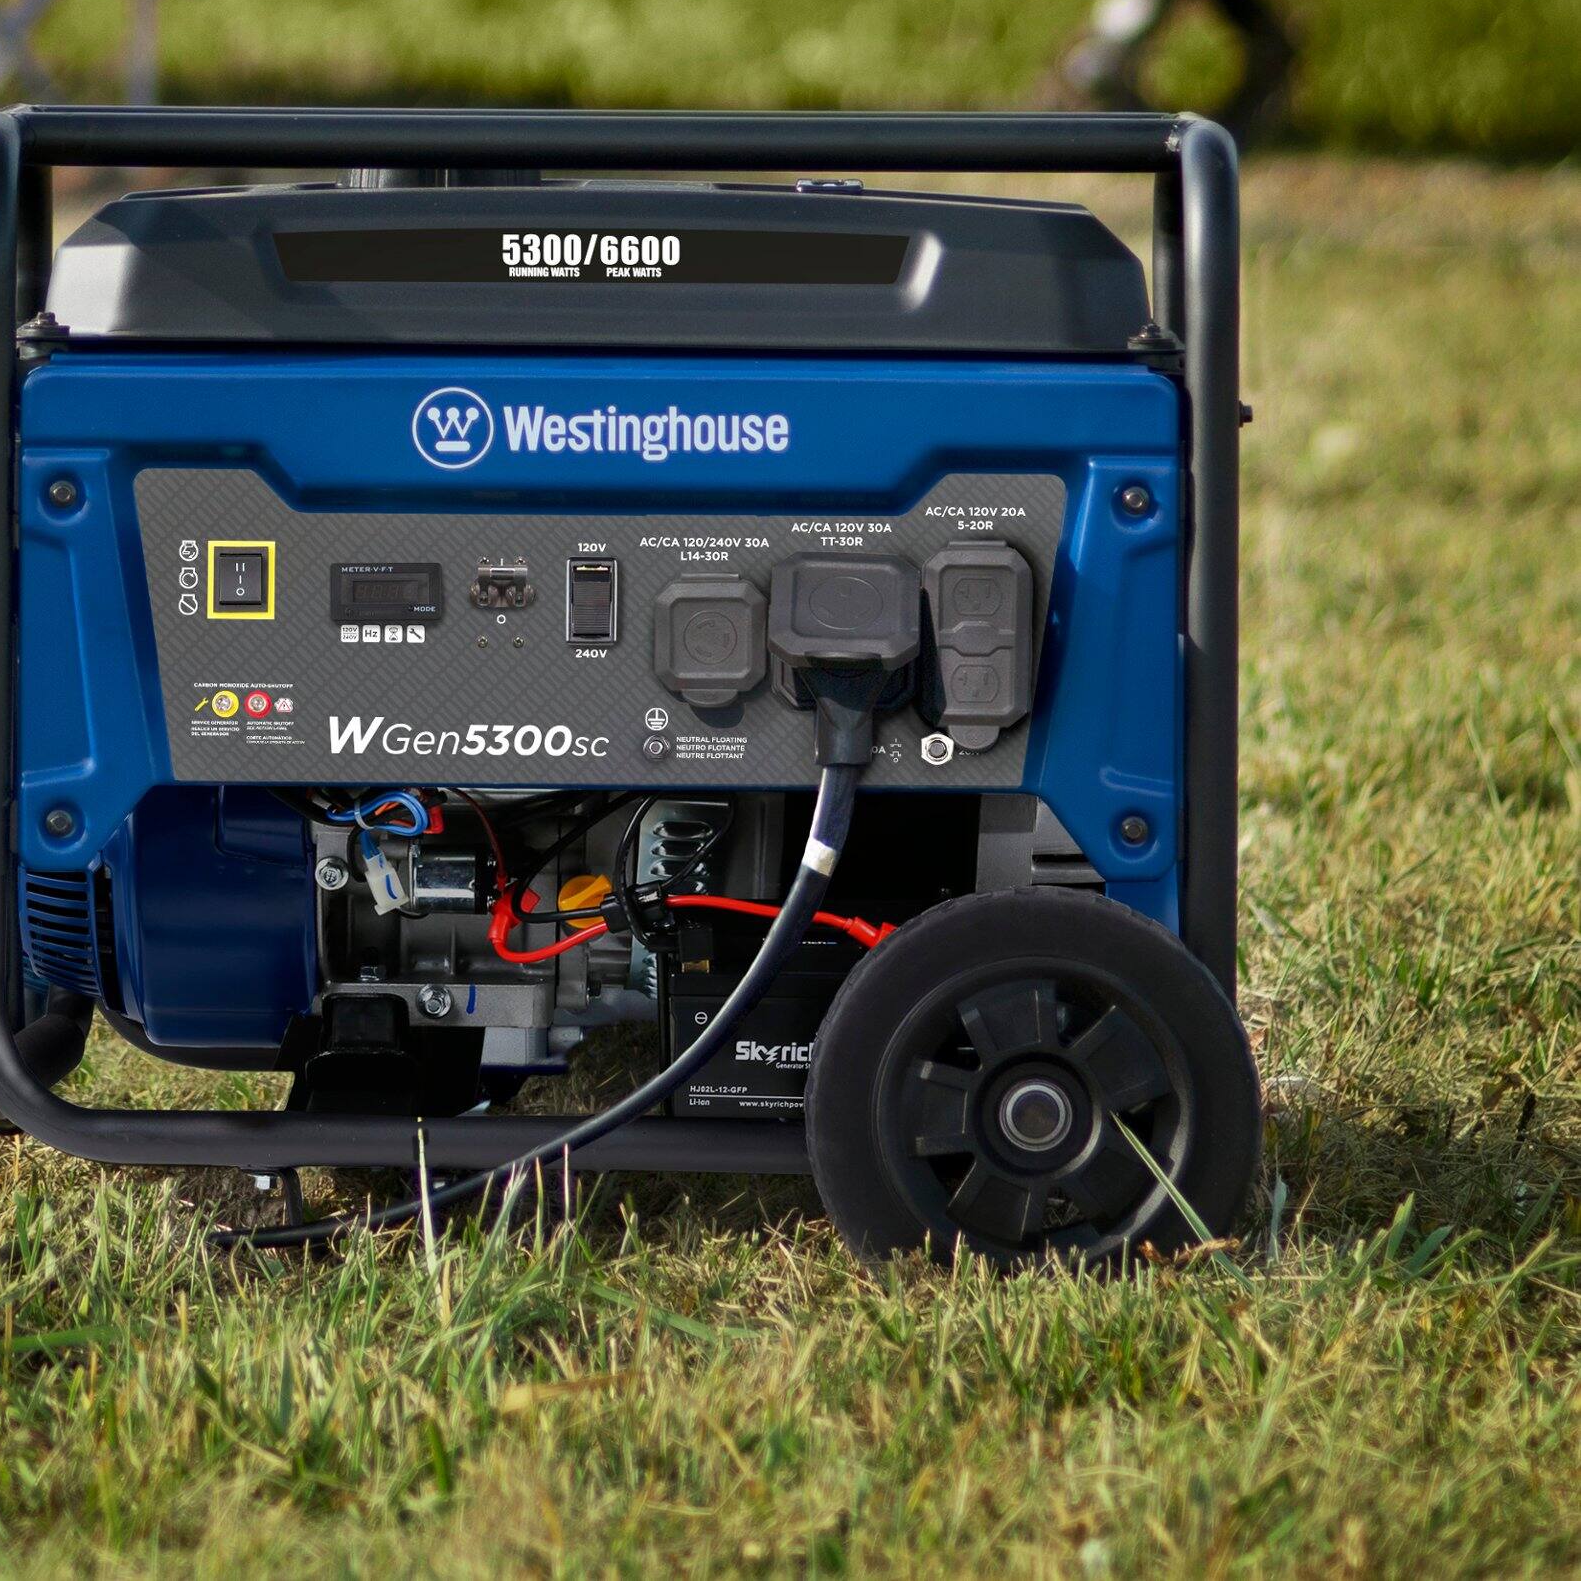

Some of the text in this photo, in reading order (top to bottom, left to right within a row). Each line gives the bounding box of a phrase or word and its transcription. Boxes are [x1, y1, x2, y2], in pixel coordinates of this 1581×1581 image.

[502, 233, 681, 266] 5300/6600
[509, 267, 581, 278] RUNNING WATTS
[606, 267, 662, 278] PEAK WATTS
[503, 405, 789, 462] Westinghouse
[925, 506, 1026, 517] AC/CA 120V 20A
[791, 522, 893, 533] AC/CA 120V 30A
[957, 520, 994, 531] 5-20R
[639, 537, 770, 549] AC/CA 120/240V 30A
[820, 536, 864, 547] TT-30R
[577, 542, 607, 553] 120V
[680, 551, 729, 562] L14-30R
[364, 629, 378, 638] Hz
[575, 648, 608, 659] 240V
[775, 1061, 805, 1069] Generator
